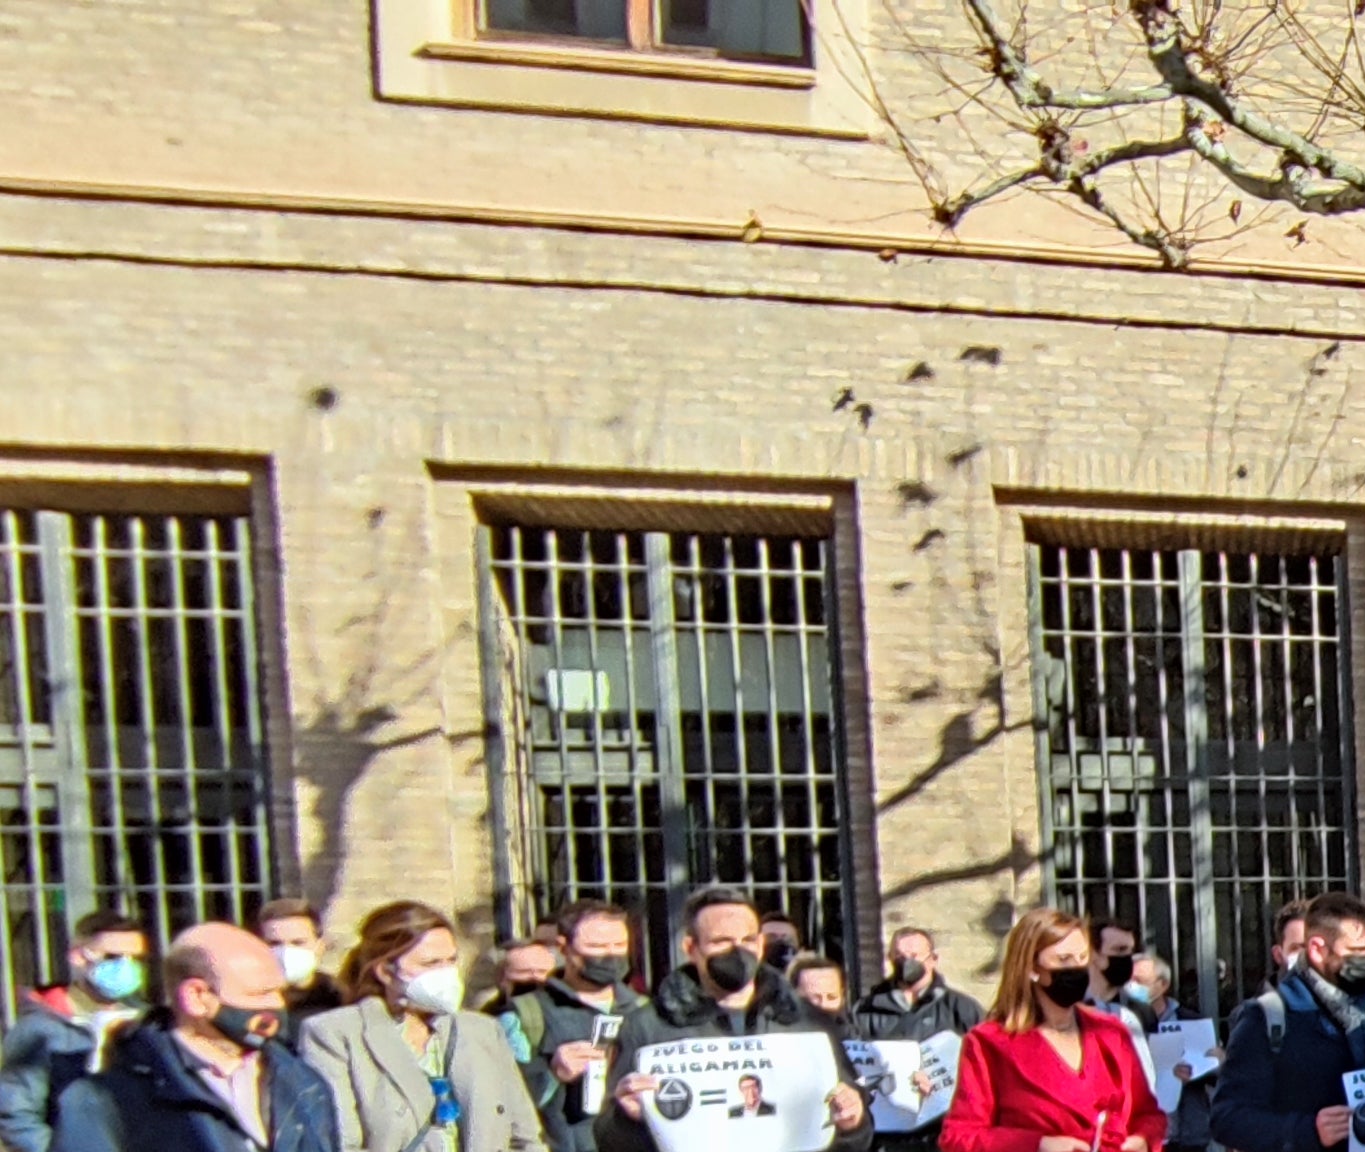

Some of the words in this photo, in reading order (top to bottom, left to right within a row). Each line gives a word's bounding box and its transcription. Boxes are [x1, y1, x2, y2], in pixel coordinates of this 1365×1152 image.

[652, 1042, 719, 1058] JUEGO
[728, 1039, 768, 1052] DEL
[650, 1057, 774, 1075] ALIGAMAR
